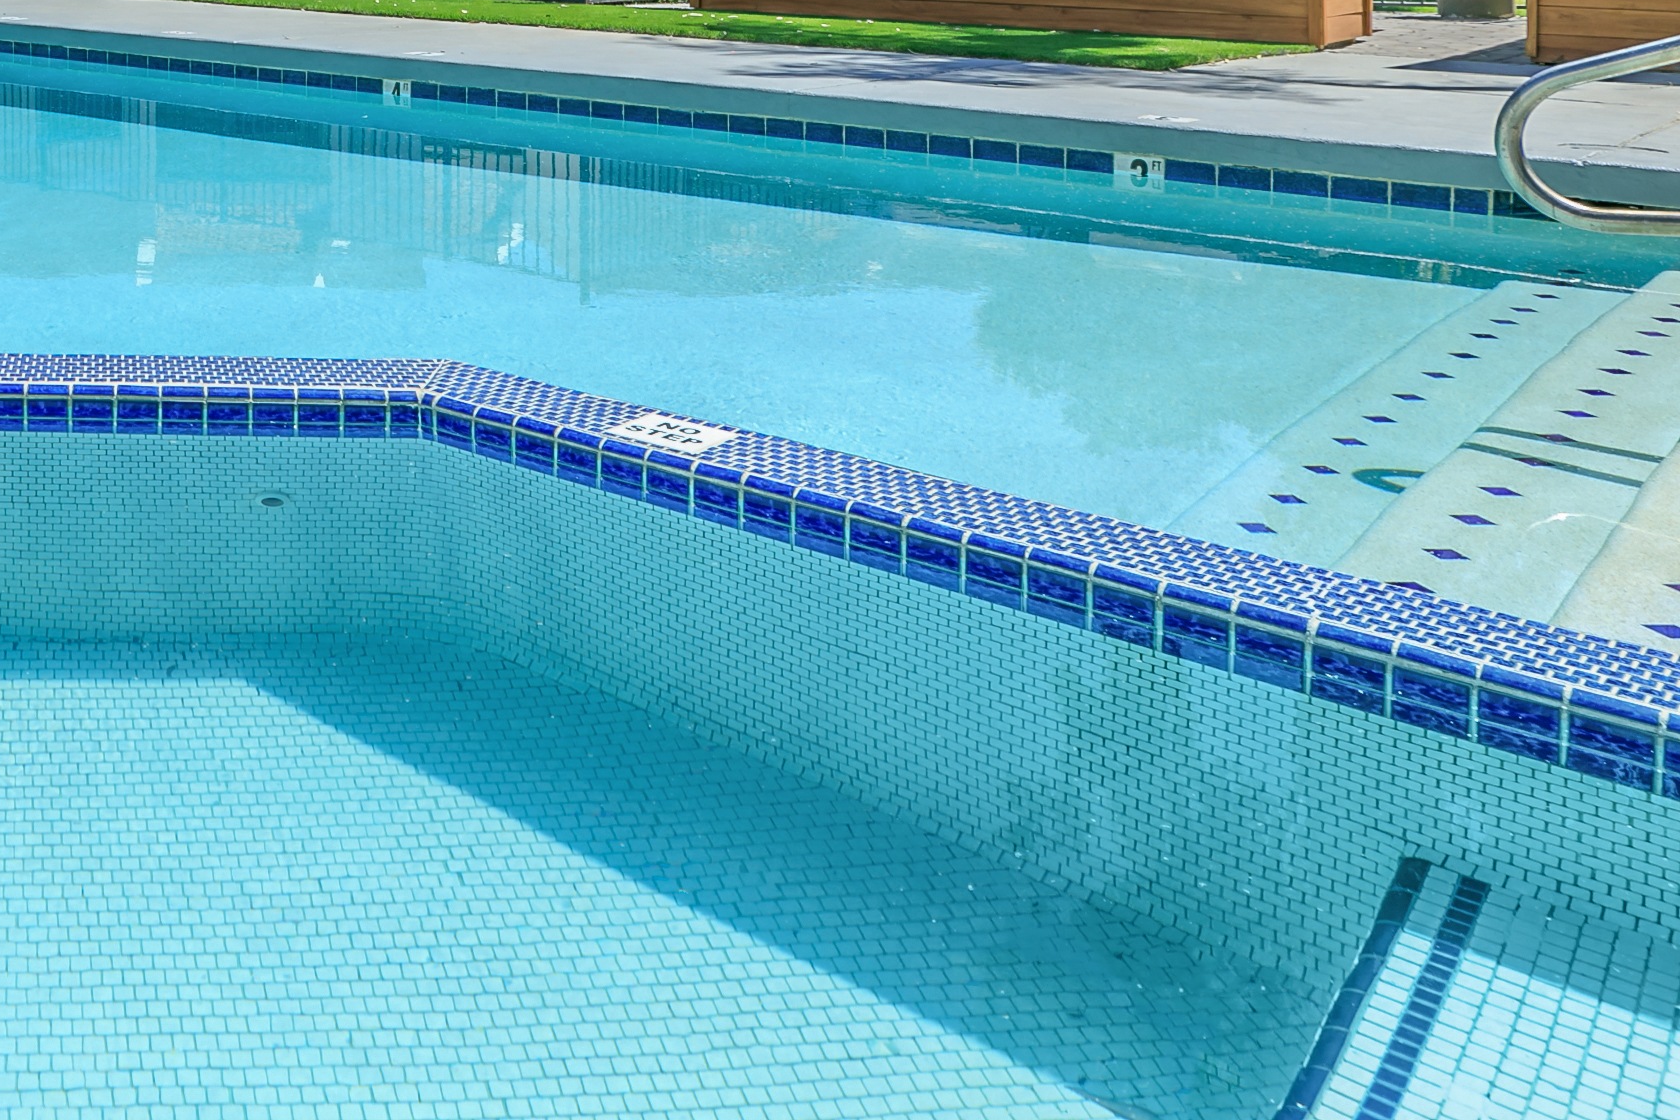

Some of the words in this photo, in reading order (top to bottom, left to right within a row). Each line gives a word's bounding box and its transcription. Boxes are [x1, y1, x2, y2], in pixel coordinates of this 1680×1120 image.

[1152, 160, 1162, 172] FT
[625, 424, 703, 444] STEP
[656, 421, 702, 435] NO
